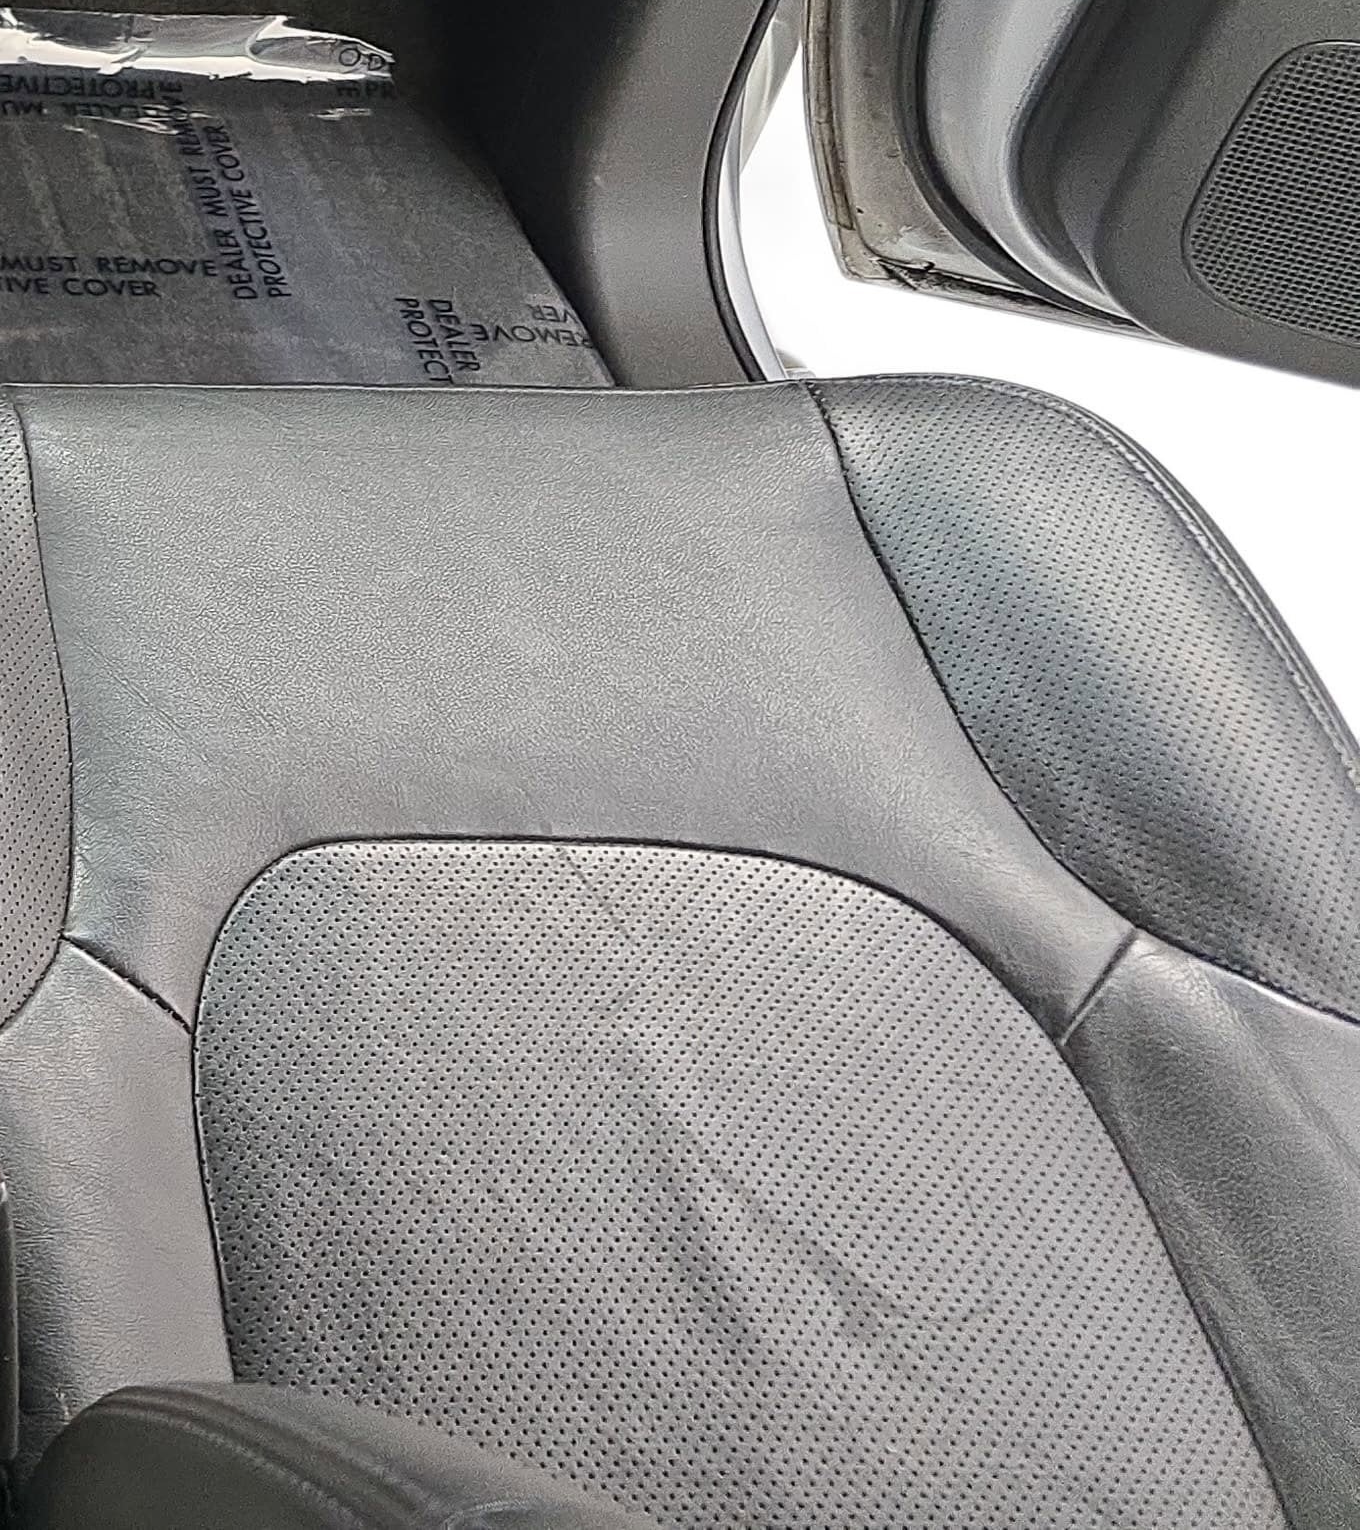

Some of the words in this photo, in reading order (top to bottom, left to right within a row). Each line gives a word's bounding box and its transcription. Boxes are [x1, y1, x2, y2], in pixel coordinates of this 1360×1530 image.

[0, 73, 155, 100] PROTECTIVE
[206, 123, 245, 182] COVER
[190, 167, 231, 218] MUST
[0, 254, 78, 273] MUST
[95, 256, 219, 277] REMOVE
[215, 229, 258, 301] DEALER
[228, 187, 292, 298] PROTECTIVE
[63, 275, 161, 298] COVER
[394, 297, 454, 385] PROTECT
[427, 299, 481, 372] DEALER
